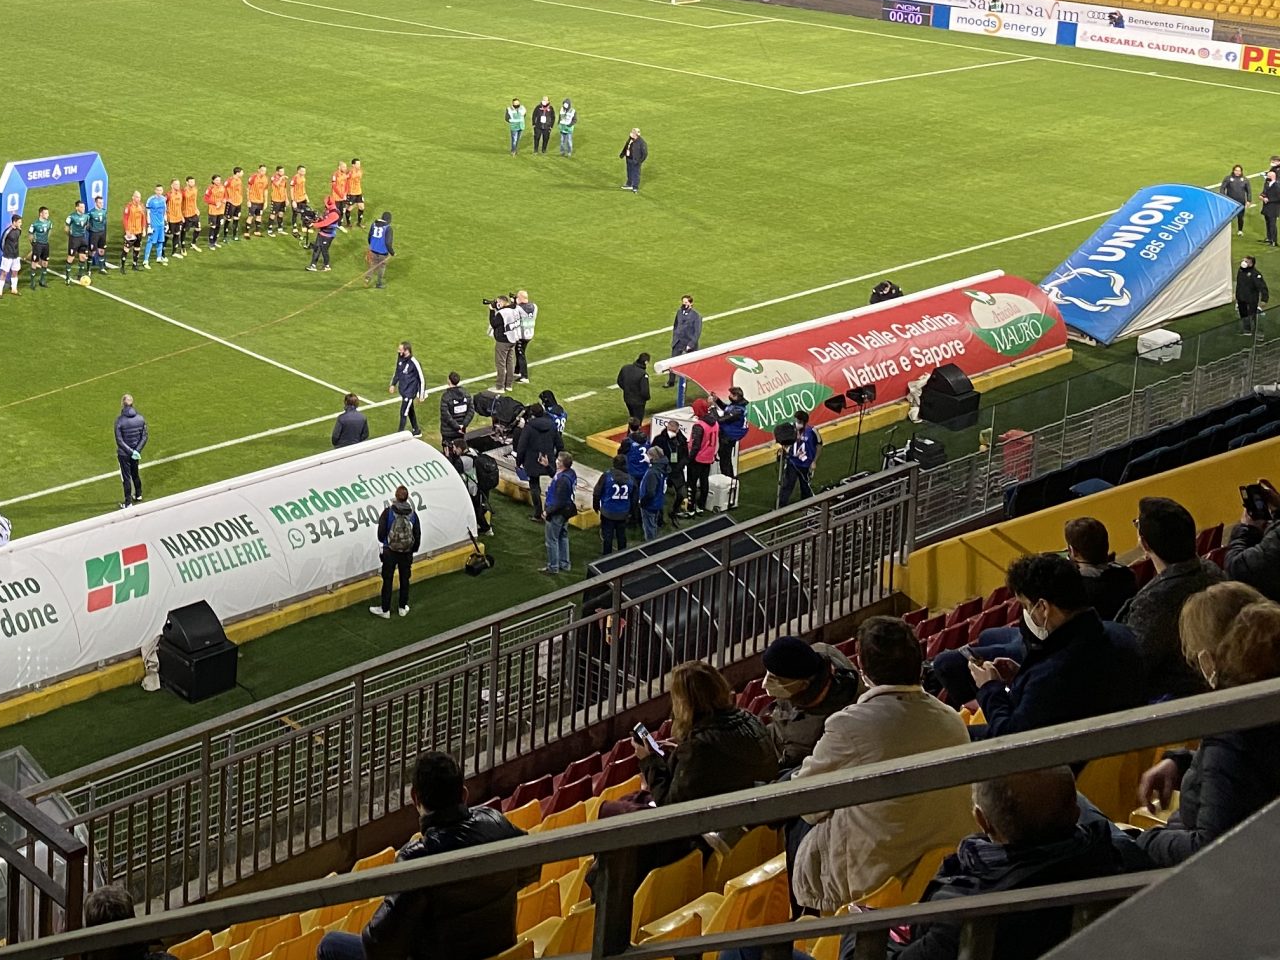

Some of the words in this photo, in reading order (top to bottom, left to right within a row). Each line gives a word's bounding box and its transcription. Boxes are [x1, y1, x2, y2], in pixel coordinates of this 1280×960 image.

[889, 11, 923, 25] 00:00
[895, 3, 920, 13] NGM
[956, 14, 997, 29] moods
[1003, 20, 1047, 37] energy
[1128, 16, 1174, 29] Benevento
[1176, 22, 1210, 33] Finauto
[1090, 34, 1145, 49] CASEAREA
[1147, 42, 1196, 56] CAUDINA
[27, 169, 51, 181] SERIE
[63, 165, 78, 176] TIM
[1088, 194, 1184, 263] UNION
[1160, 211, 1195, 234] luce
[1160, 231, 1173, 242] e
[1139, 239, 1165, 261] gas
[807, 341, 860, 364] Dalla
[849, 330, 898, 351] Valle
[890, 312, 961, 339] Caudina
[990, 319, 1043, 354] MAURO
[842, 359, 900, 389] Natura
[899, 355, 912, 372] e
[909, 339, 966, 367] Sapore
[756, 370, 792, 396] Avicola
[752, 389, 816, 429] MAURO
[269, 459, 449, 526] nardoneforni.com
[611, 484, 629, 500] 22
[160, 514, 260, 559] NARDONE
[304, 516, 345, 544] 342
[343, 505, 380, 532] 540
[176, 538, 271, 584] HOTELLERIE
